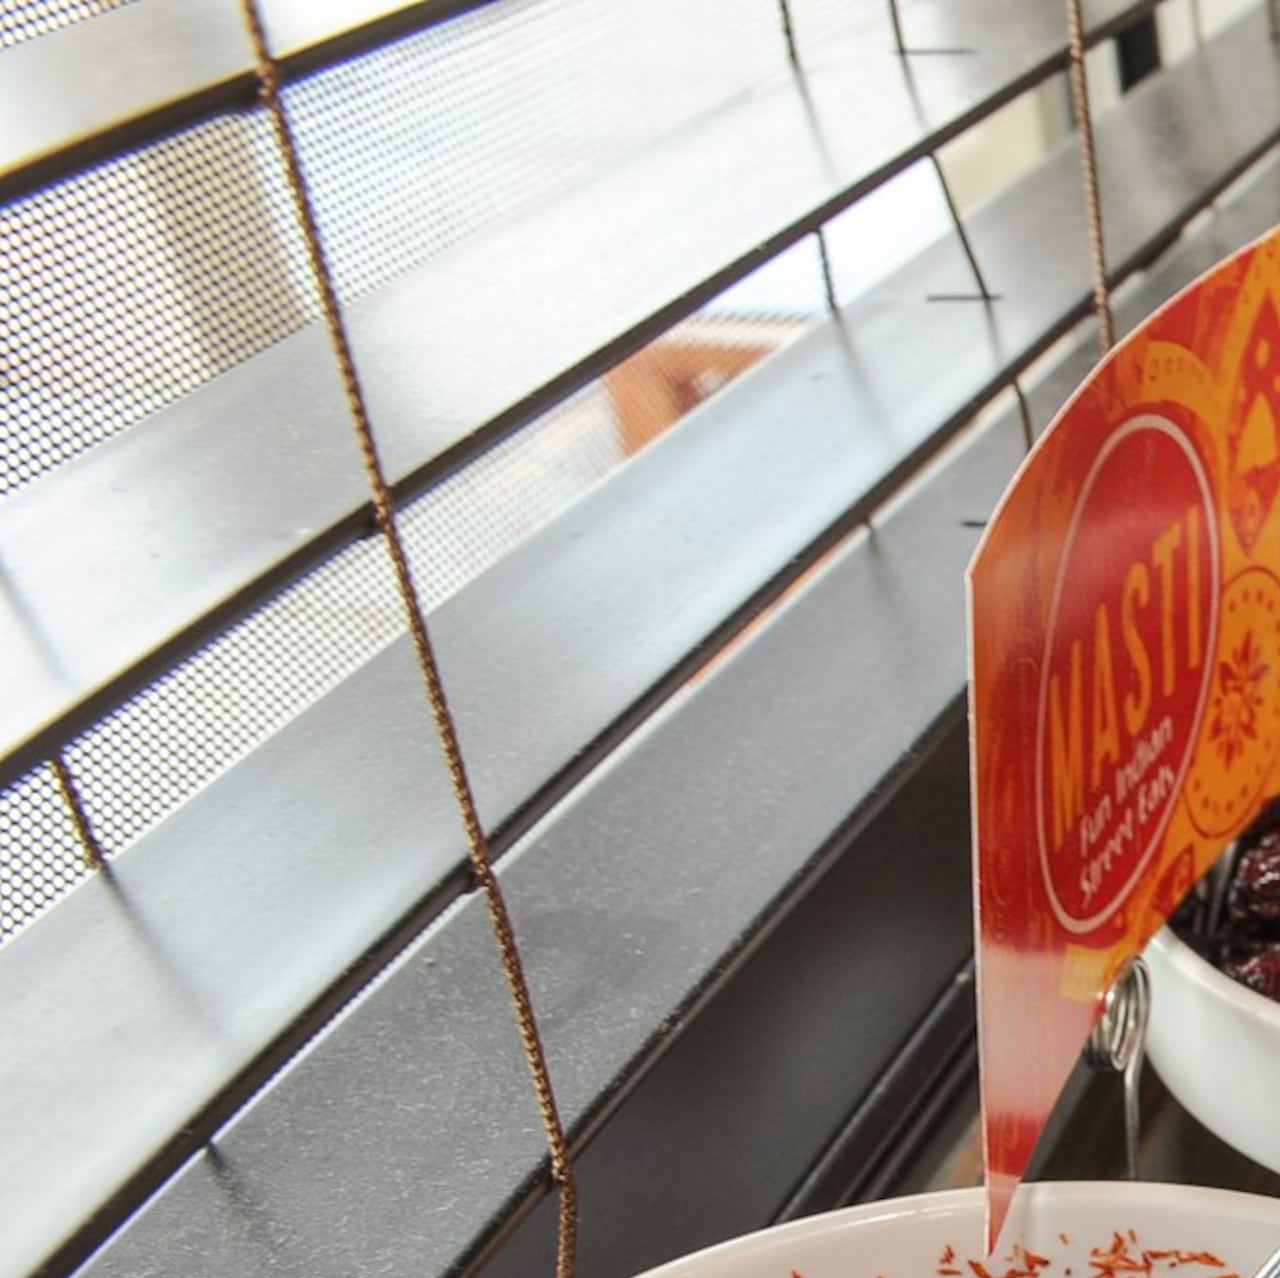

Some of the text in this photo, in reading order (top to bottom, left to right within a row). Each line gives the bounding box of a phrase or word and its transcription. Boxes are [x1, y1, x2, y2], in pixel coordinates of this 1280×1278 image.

[1049, 505, 1202, 853] MASTI
[1079, 715, 1173, 858] Fun Indian
[1079, 764, 1175, 909] Street Eats
